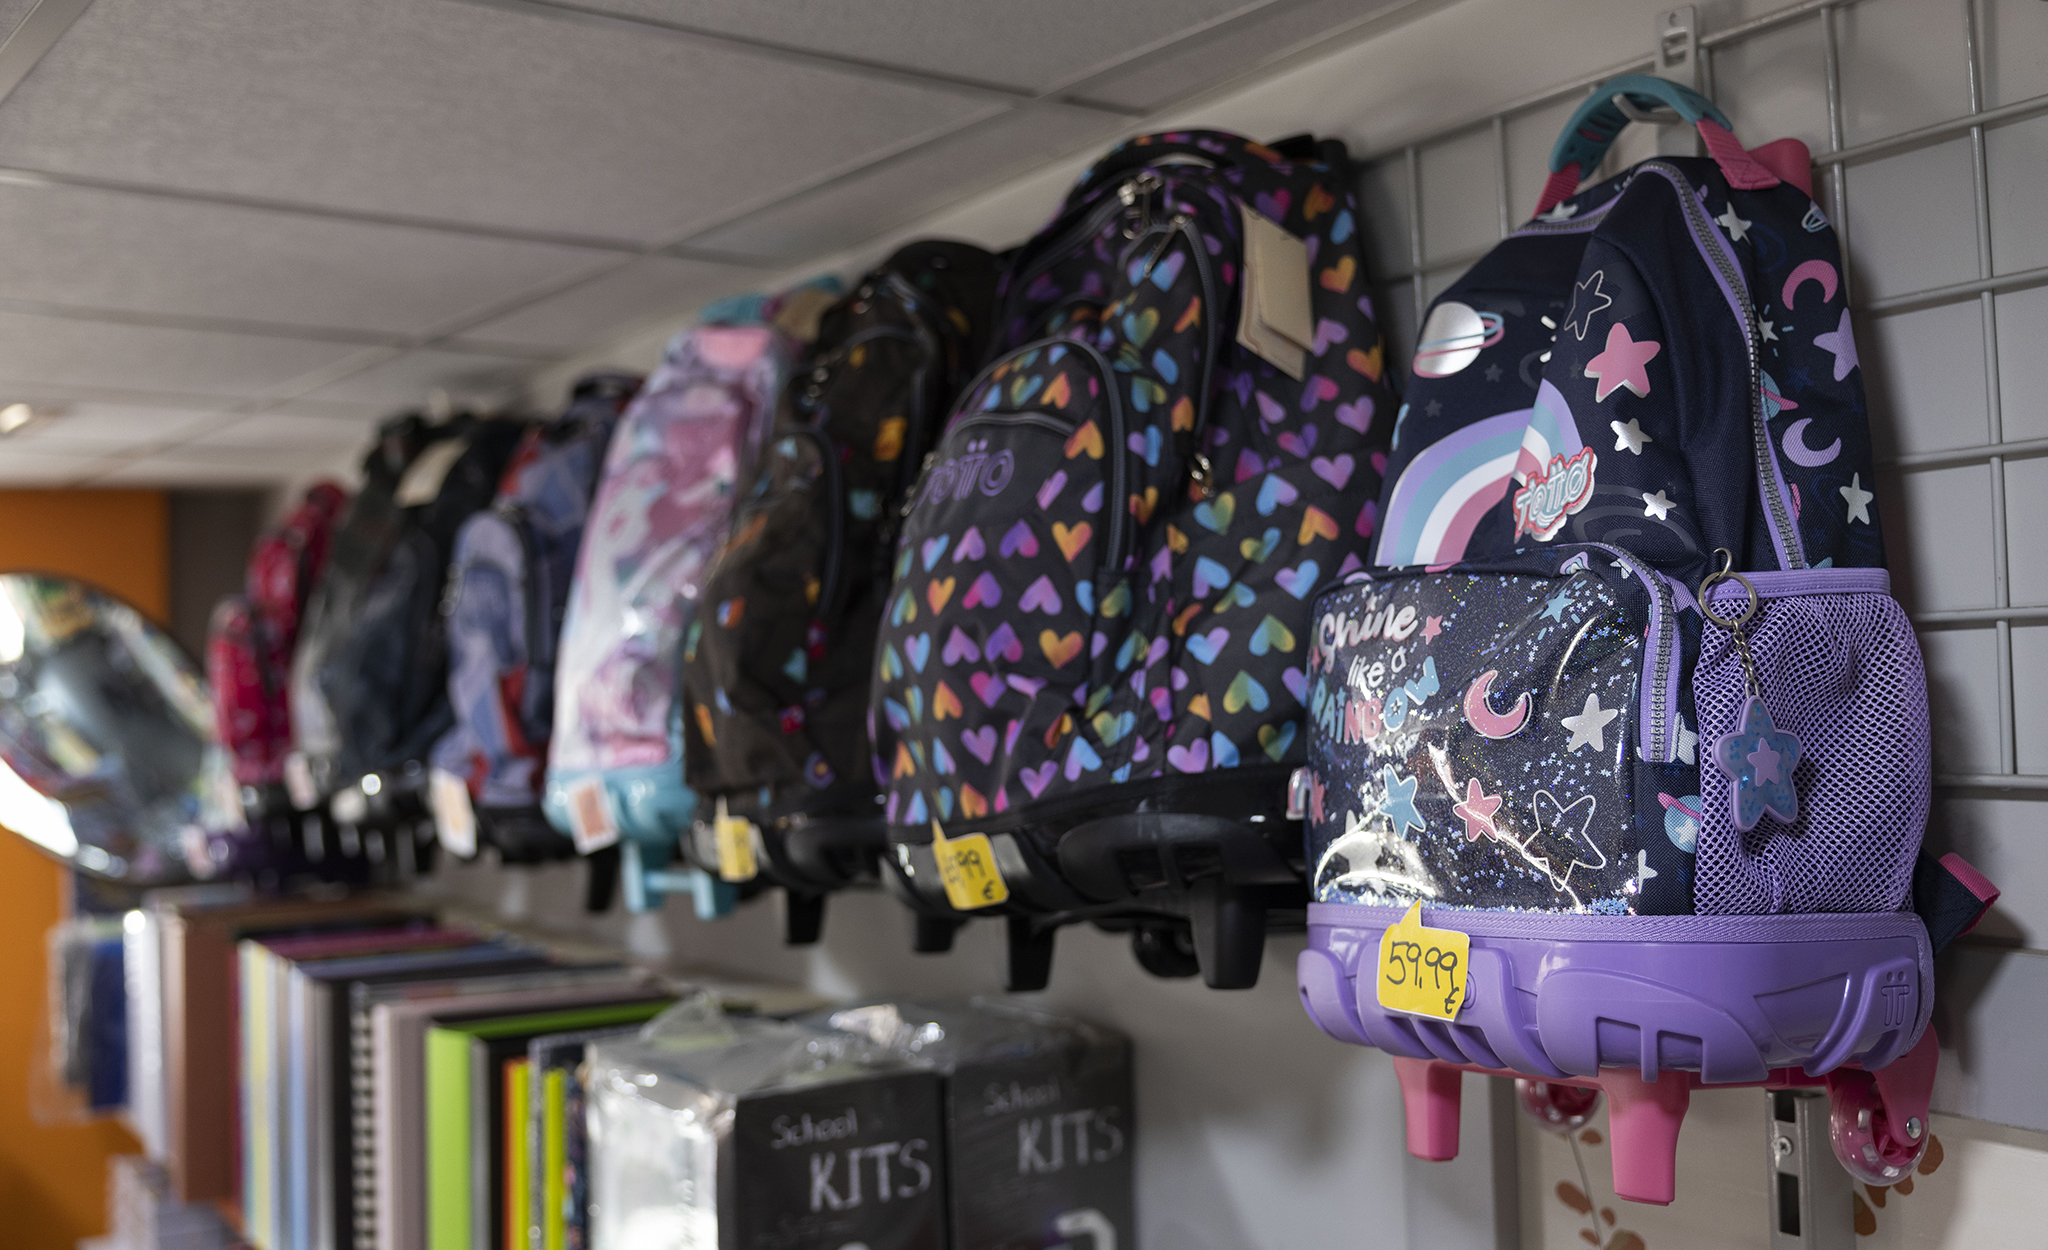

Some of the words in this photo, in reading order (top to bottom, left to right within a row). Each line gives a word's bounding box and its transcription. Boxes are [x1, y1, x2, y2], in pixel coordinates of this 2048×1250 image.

[1318, 595, 1418, 674] Shine
[1346, 654, 1386, 689] like
[1391, 645, 1407, 673] a
[1386, 941, 1458, 989] 59,99
[771, 1107, 858, 1149] School
[1018, 1105, 1124, 1174] KITS
[810, 1138, 931, 1212] KITS
